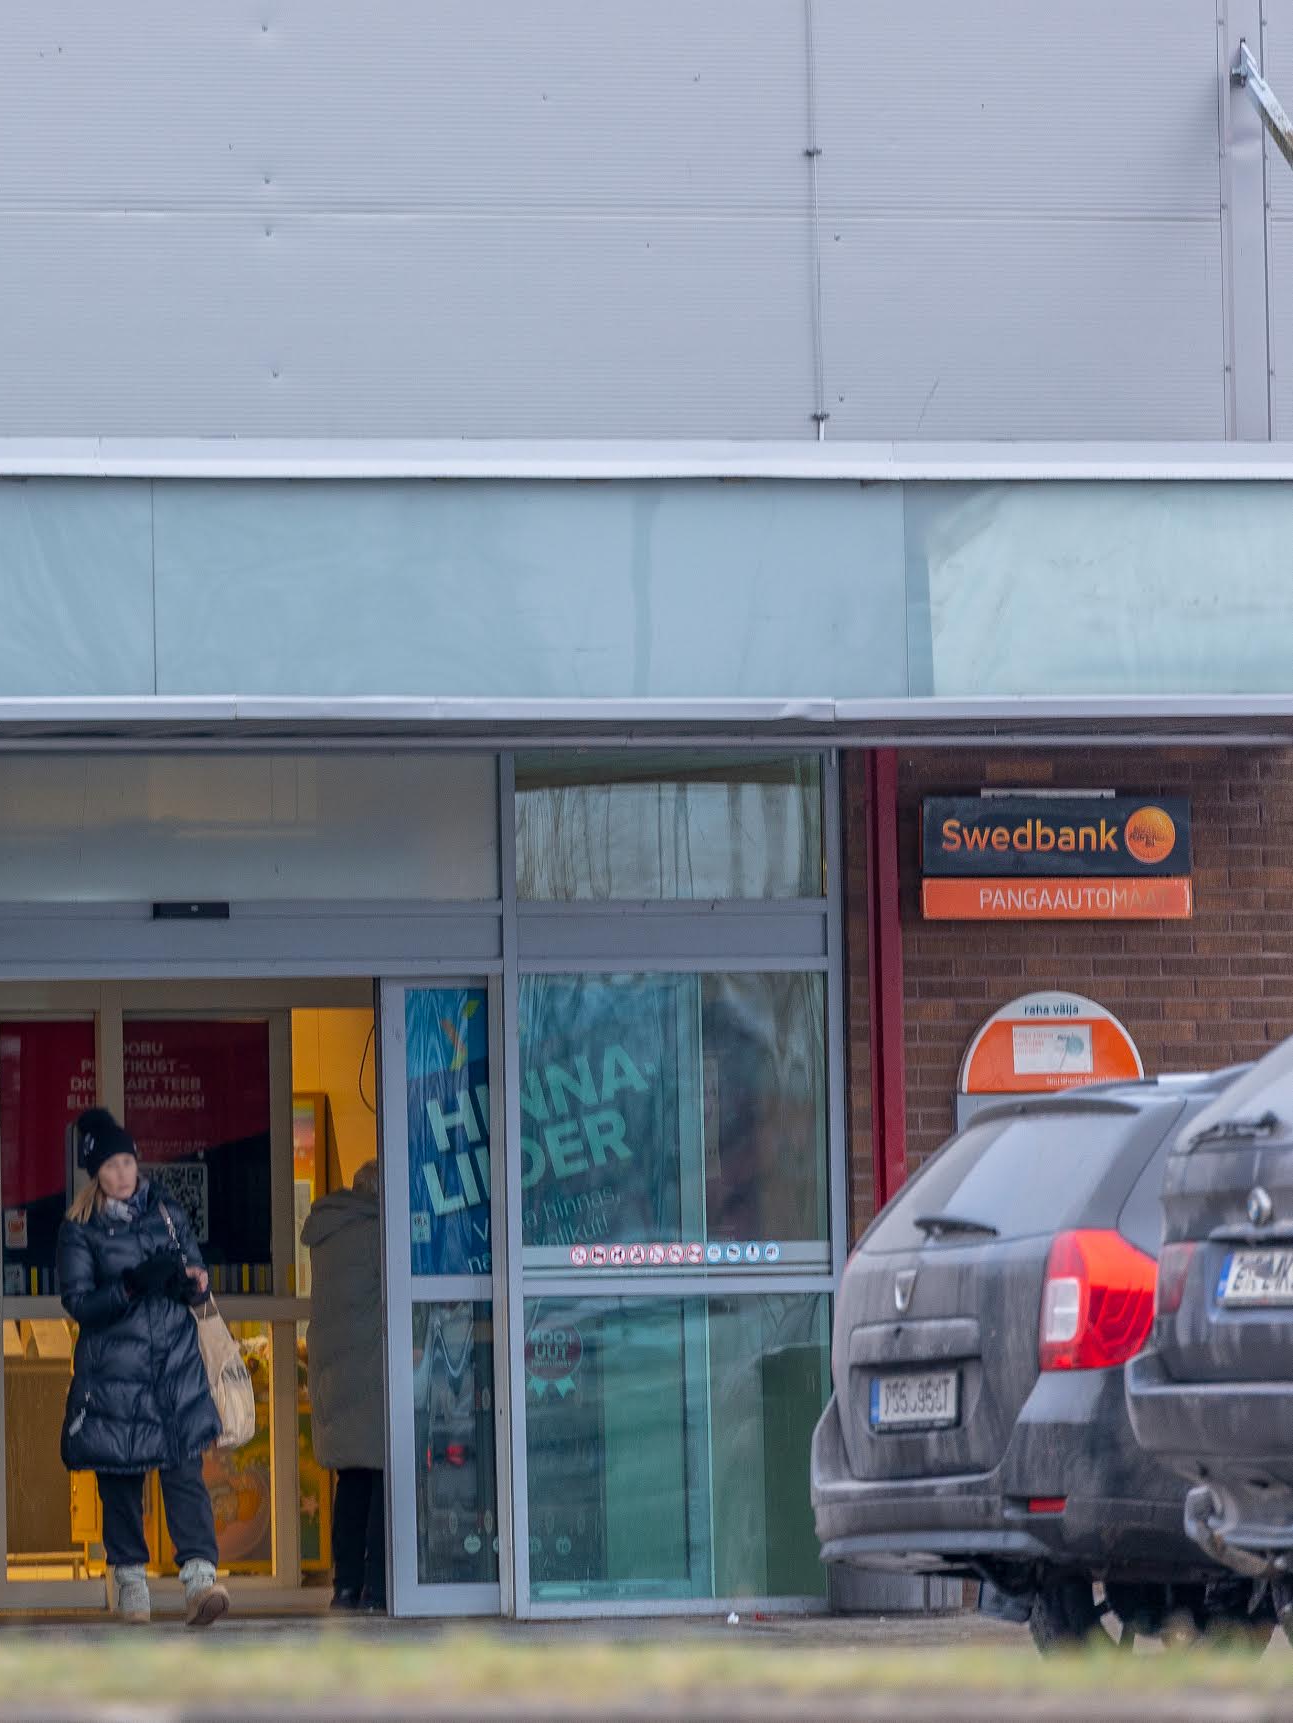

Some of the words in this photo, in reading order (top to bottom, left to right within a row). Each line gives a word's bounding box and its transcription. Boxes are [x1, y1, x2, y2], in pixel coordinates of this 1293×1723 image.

[941, 818, 1119, 852] Swedbank
[1024, 1005, 1049, 1016] raha
[1053, 1002, 1079, 1017] välja
